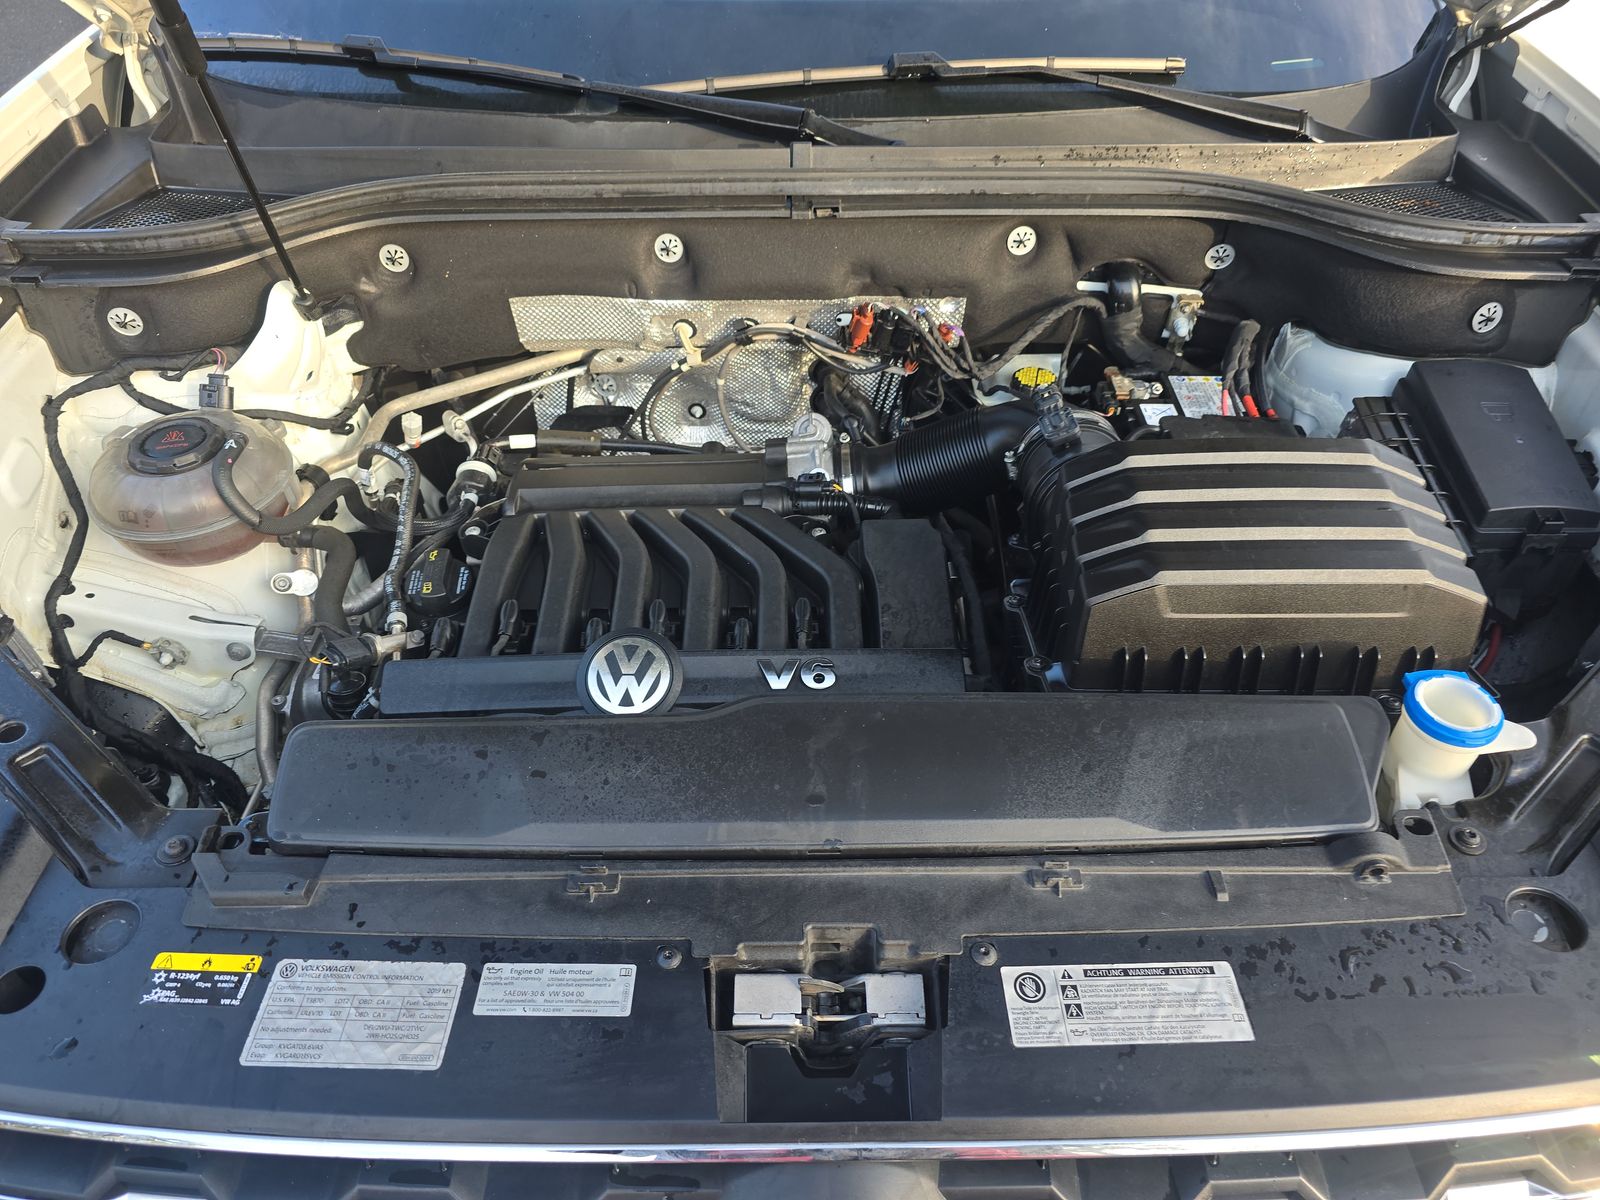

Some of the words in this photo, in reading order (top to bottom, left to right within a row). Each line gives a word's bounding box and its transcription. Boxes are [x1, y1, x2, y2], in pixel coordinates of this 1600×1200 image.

[757, 658, 836, 691] V6
[301, 964, 356, 973] VOLKSWAGEN
[510, 967, 533, 977] Engine
[549, 968, 568, 976] Huile
[1086, 969, 1124, 977] ACHTUNG
[1127, 968, 1165, 976] WARNING
[1168, 967, 1210, 975] ATTENTION
[169, 972, 201, 983] R-1234yf
[269, 1026, 307, 1034] adjustments
